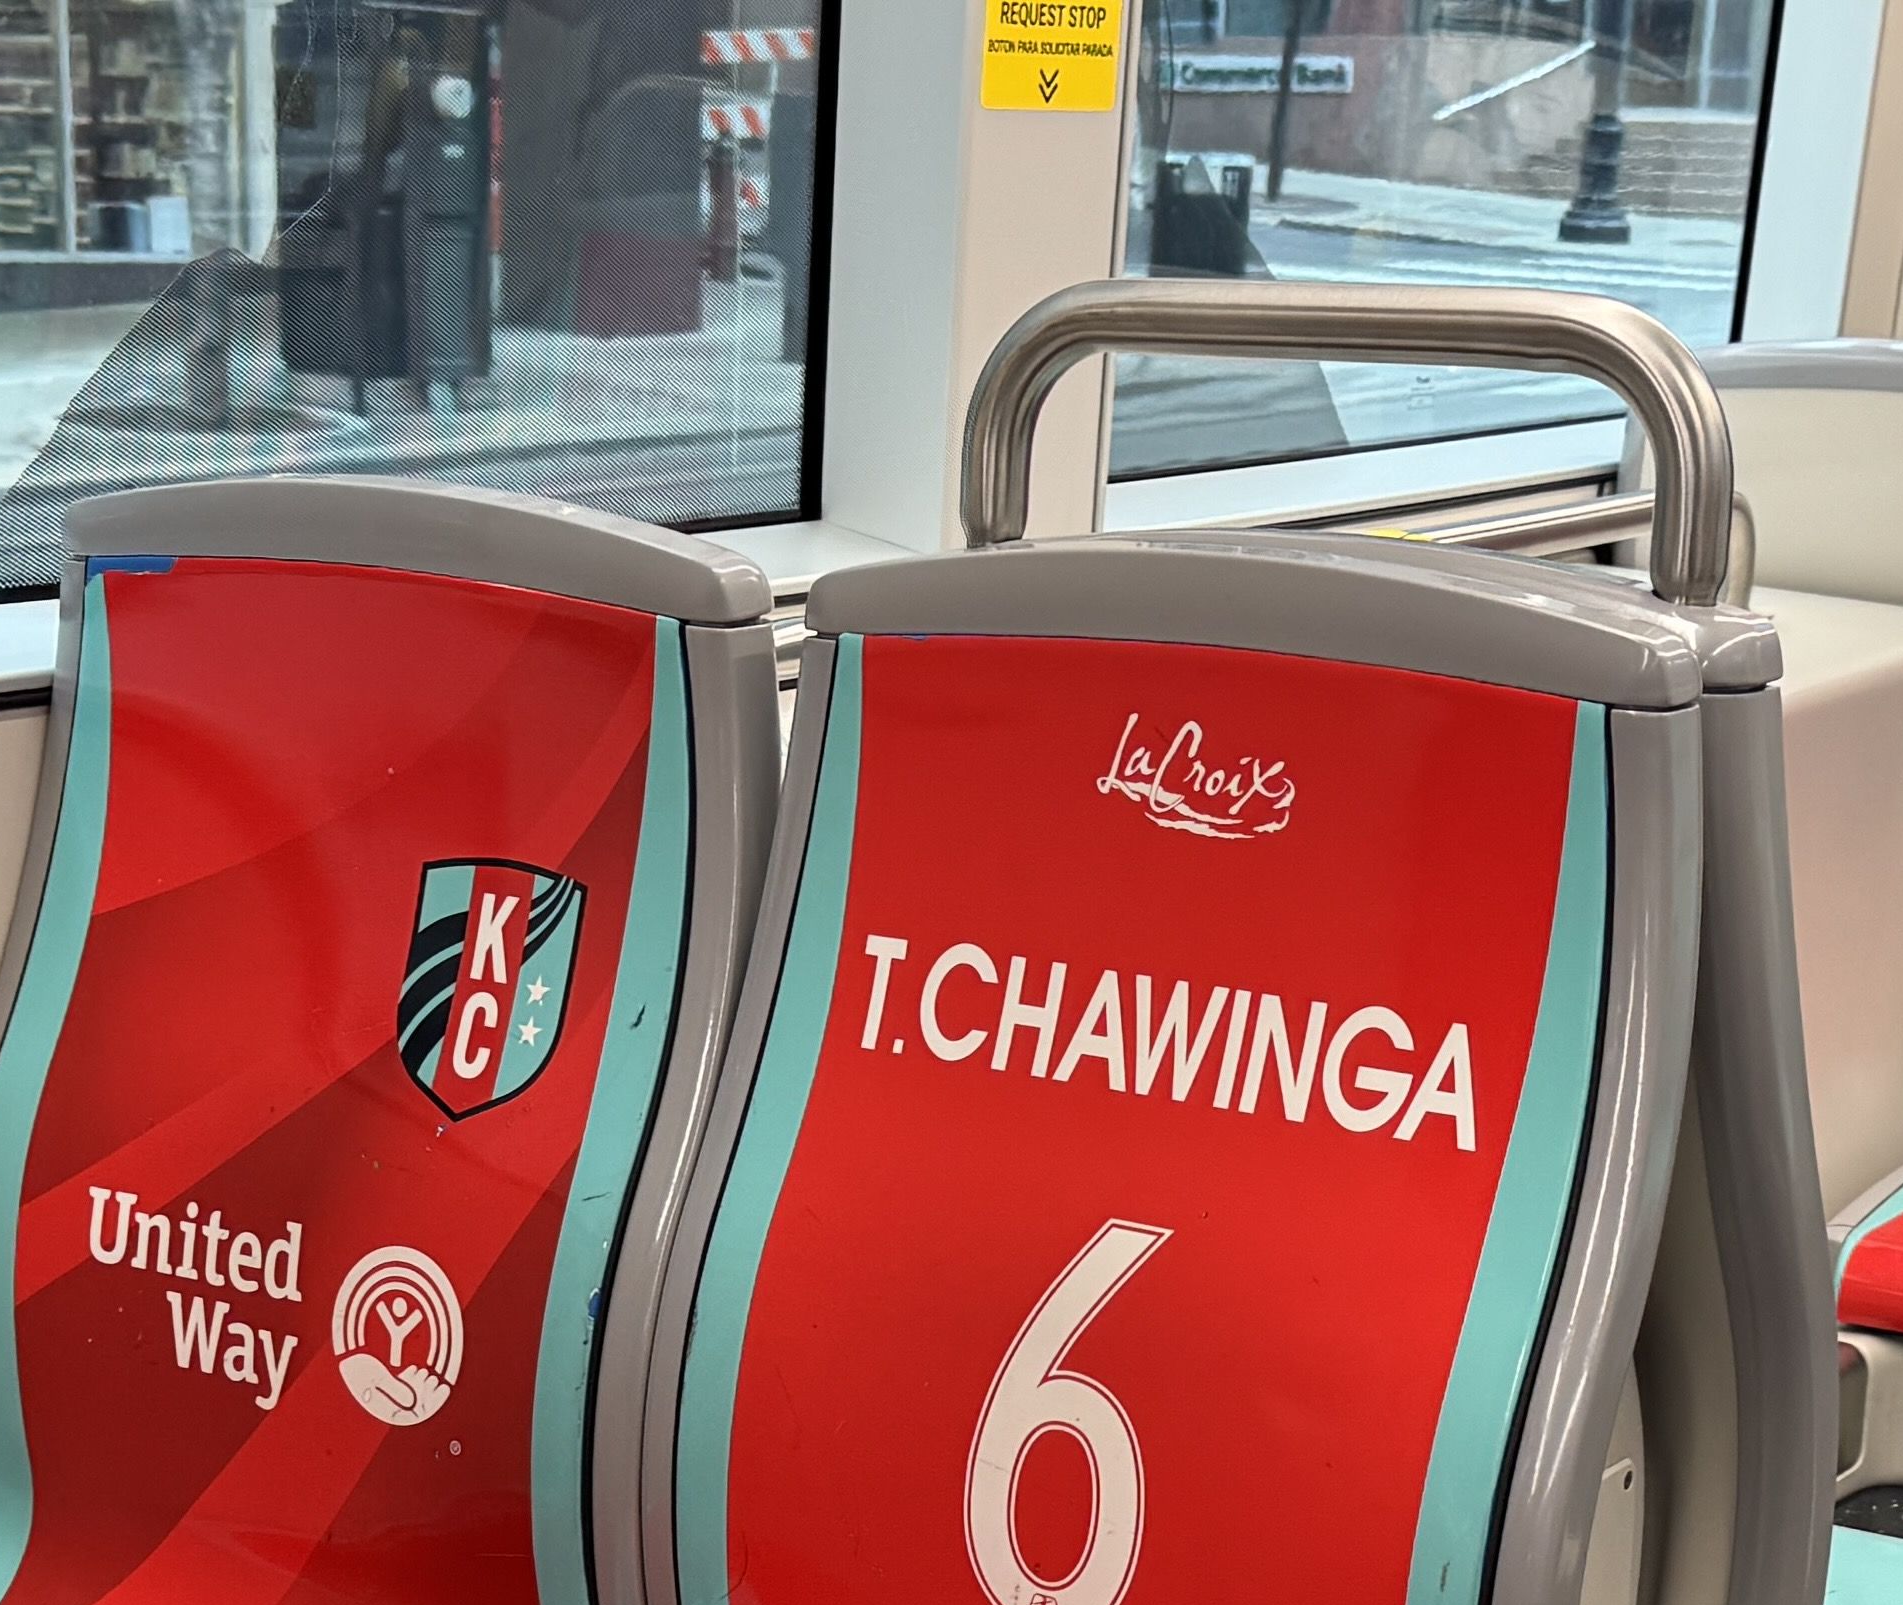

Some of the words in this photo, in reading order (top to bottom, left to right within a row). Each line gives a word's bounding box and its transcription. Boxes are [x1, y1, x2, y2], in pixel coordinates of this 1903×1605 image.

[1000, 1, 1065, 27] REQUEST
[1068, 6, 1107, 29] STOP
[1017, 40, 1038, 54] PARA
[1082, 43, 1114, 57] PARADA
[860, 934, 1476, 1152] T.CHAWINGA
[89, 1186, 302, 1302] United
[166, 1290, 298, 1411] Way
